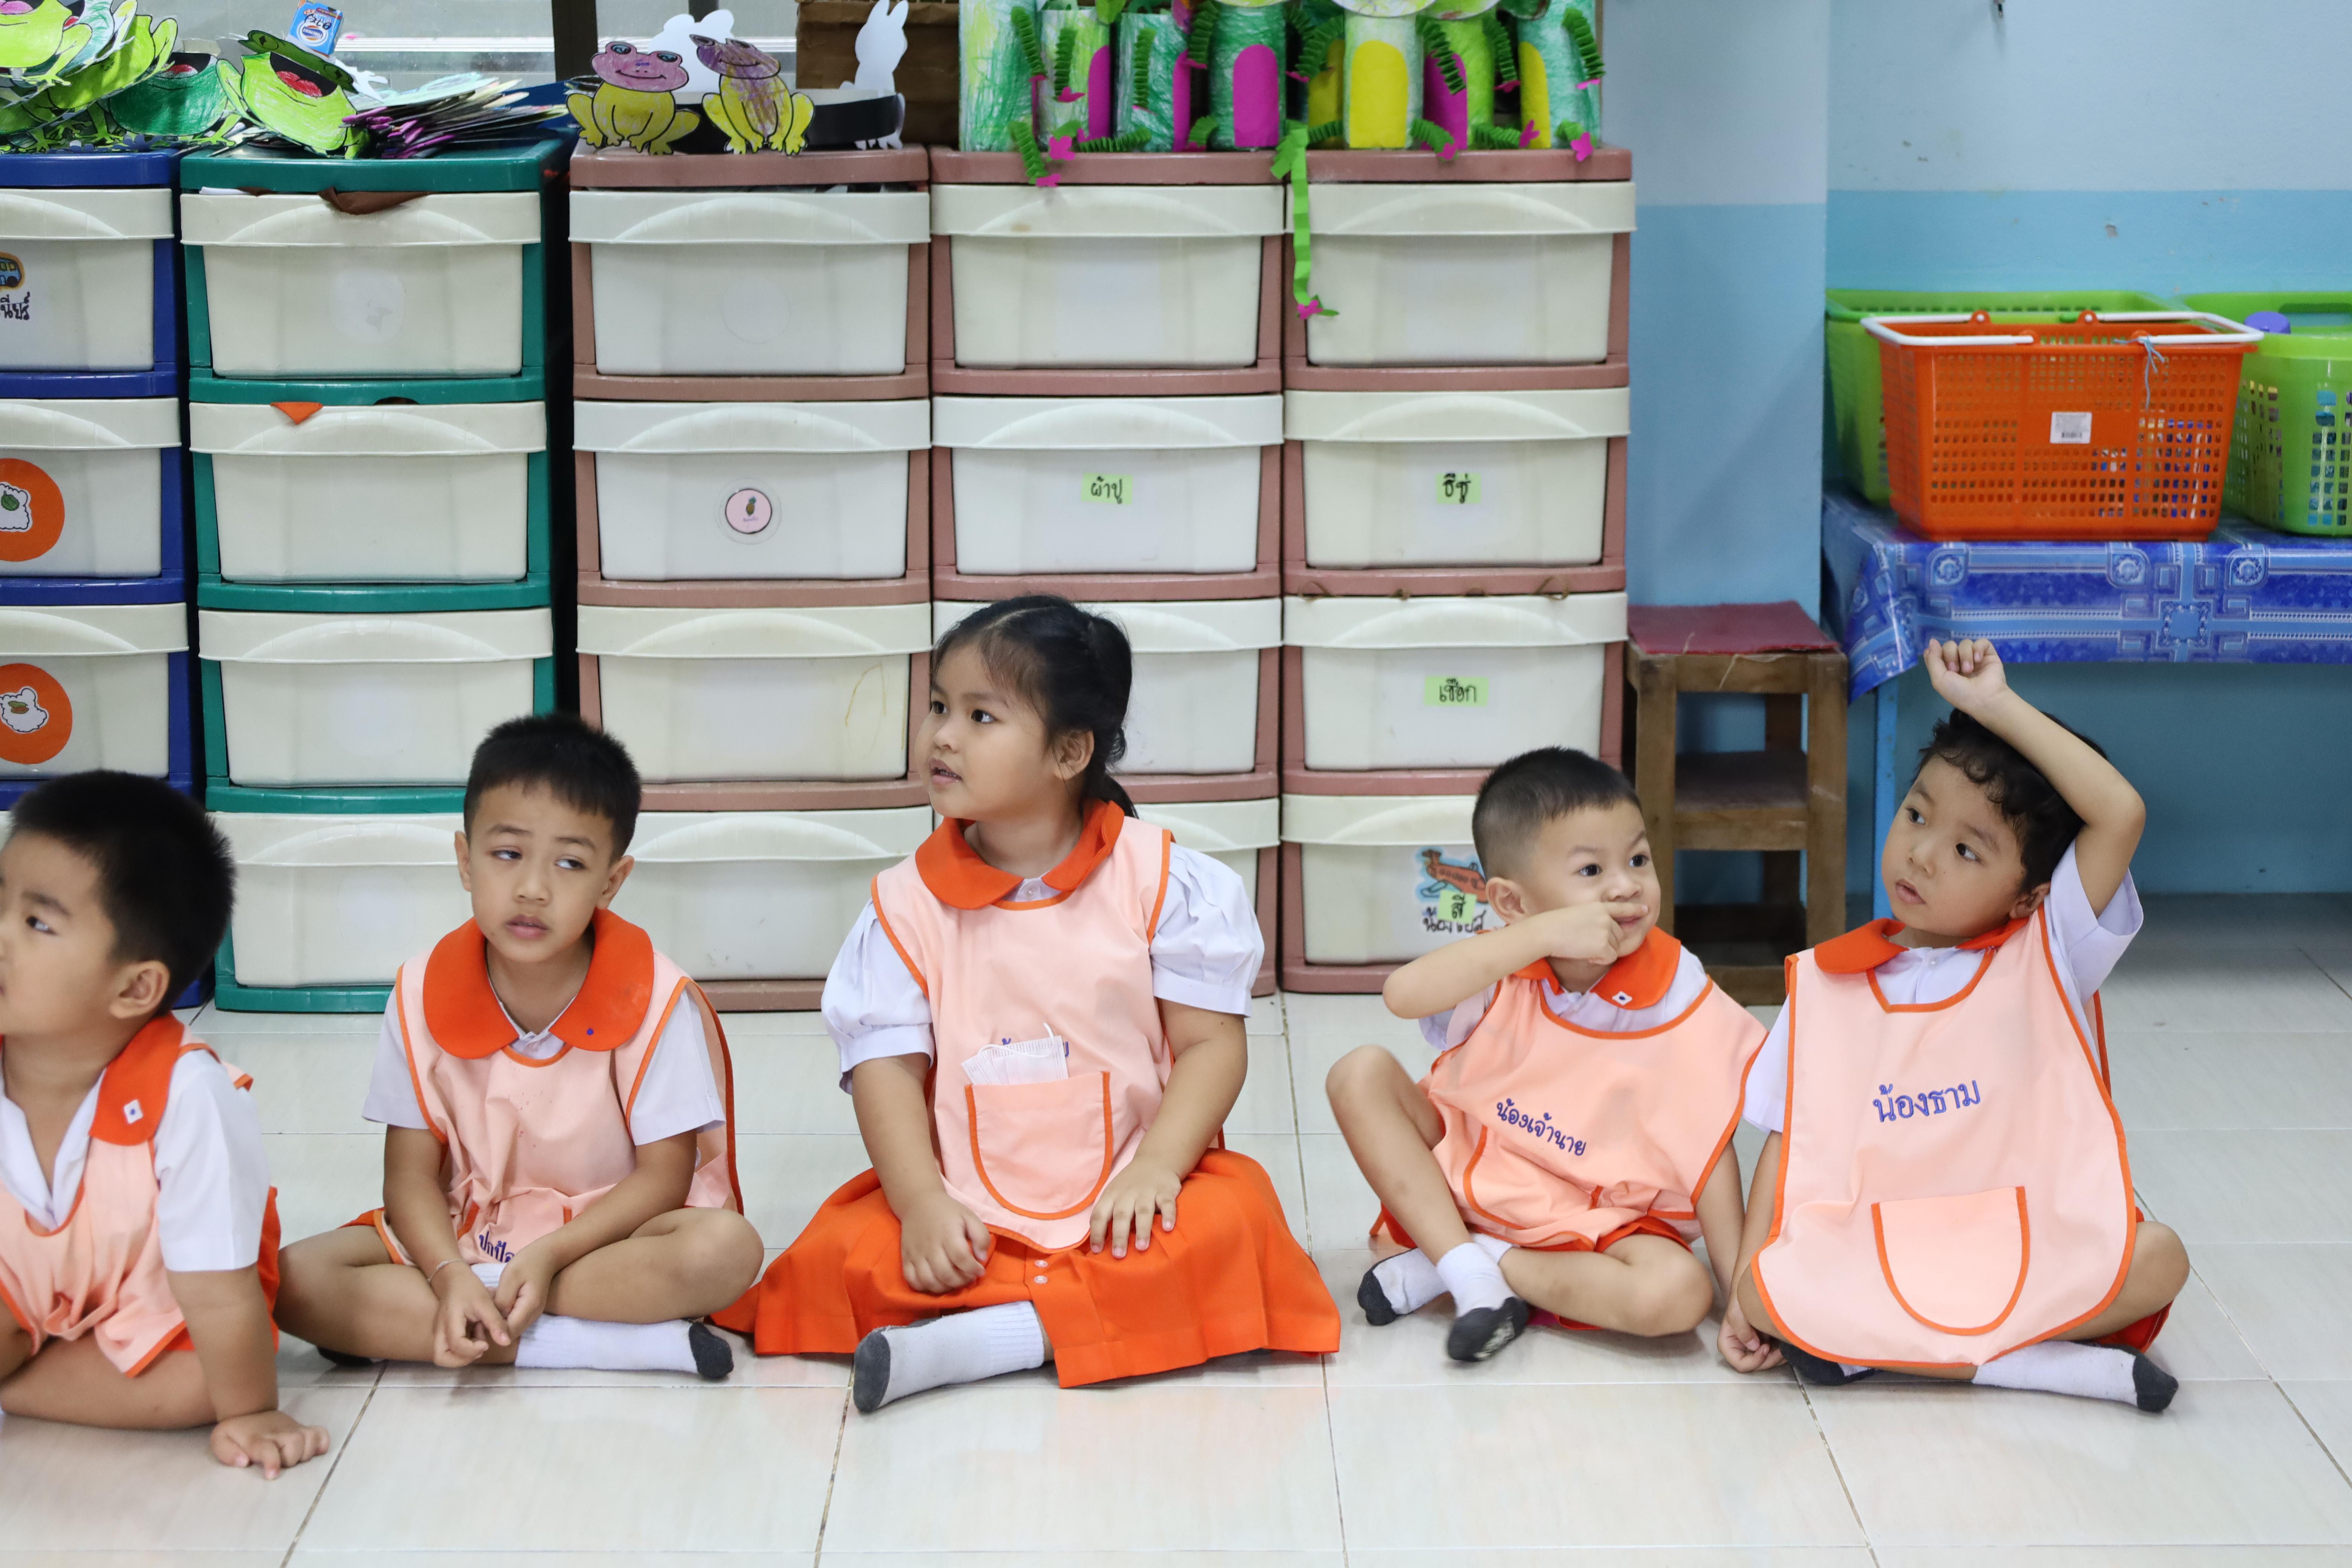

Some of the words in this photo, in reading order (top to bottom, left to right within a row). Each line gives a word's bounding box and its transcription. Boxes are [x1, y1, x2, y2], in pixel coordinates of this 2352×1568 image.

[303, 27, 323, 37] FOREMOST
[0, 291, 30, 320] นียร์
[1873, 1080, 1981, 1122] น้องธาม
[1496, 1098, 1586, 1156] น้องเจ้านาย
